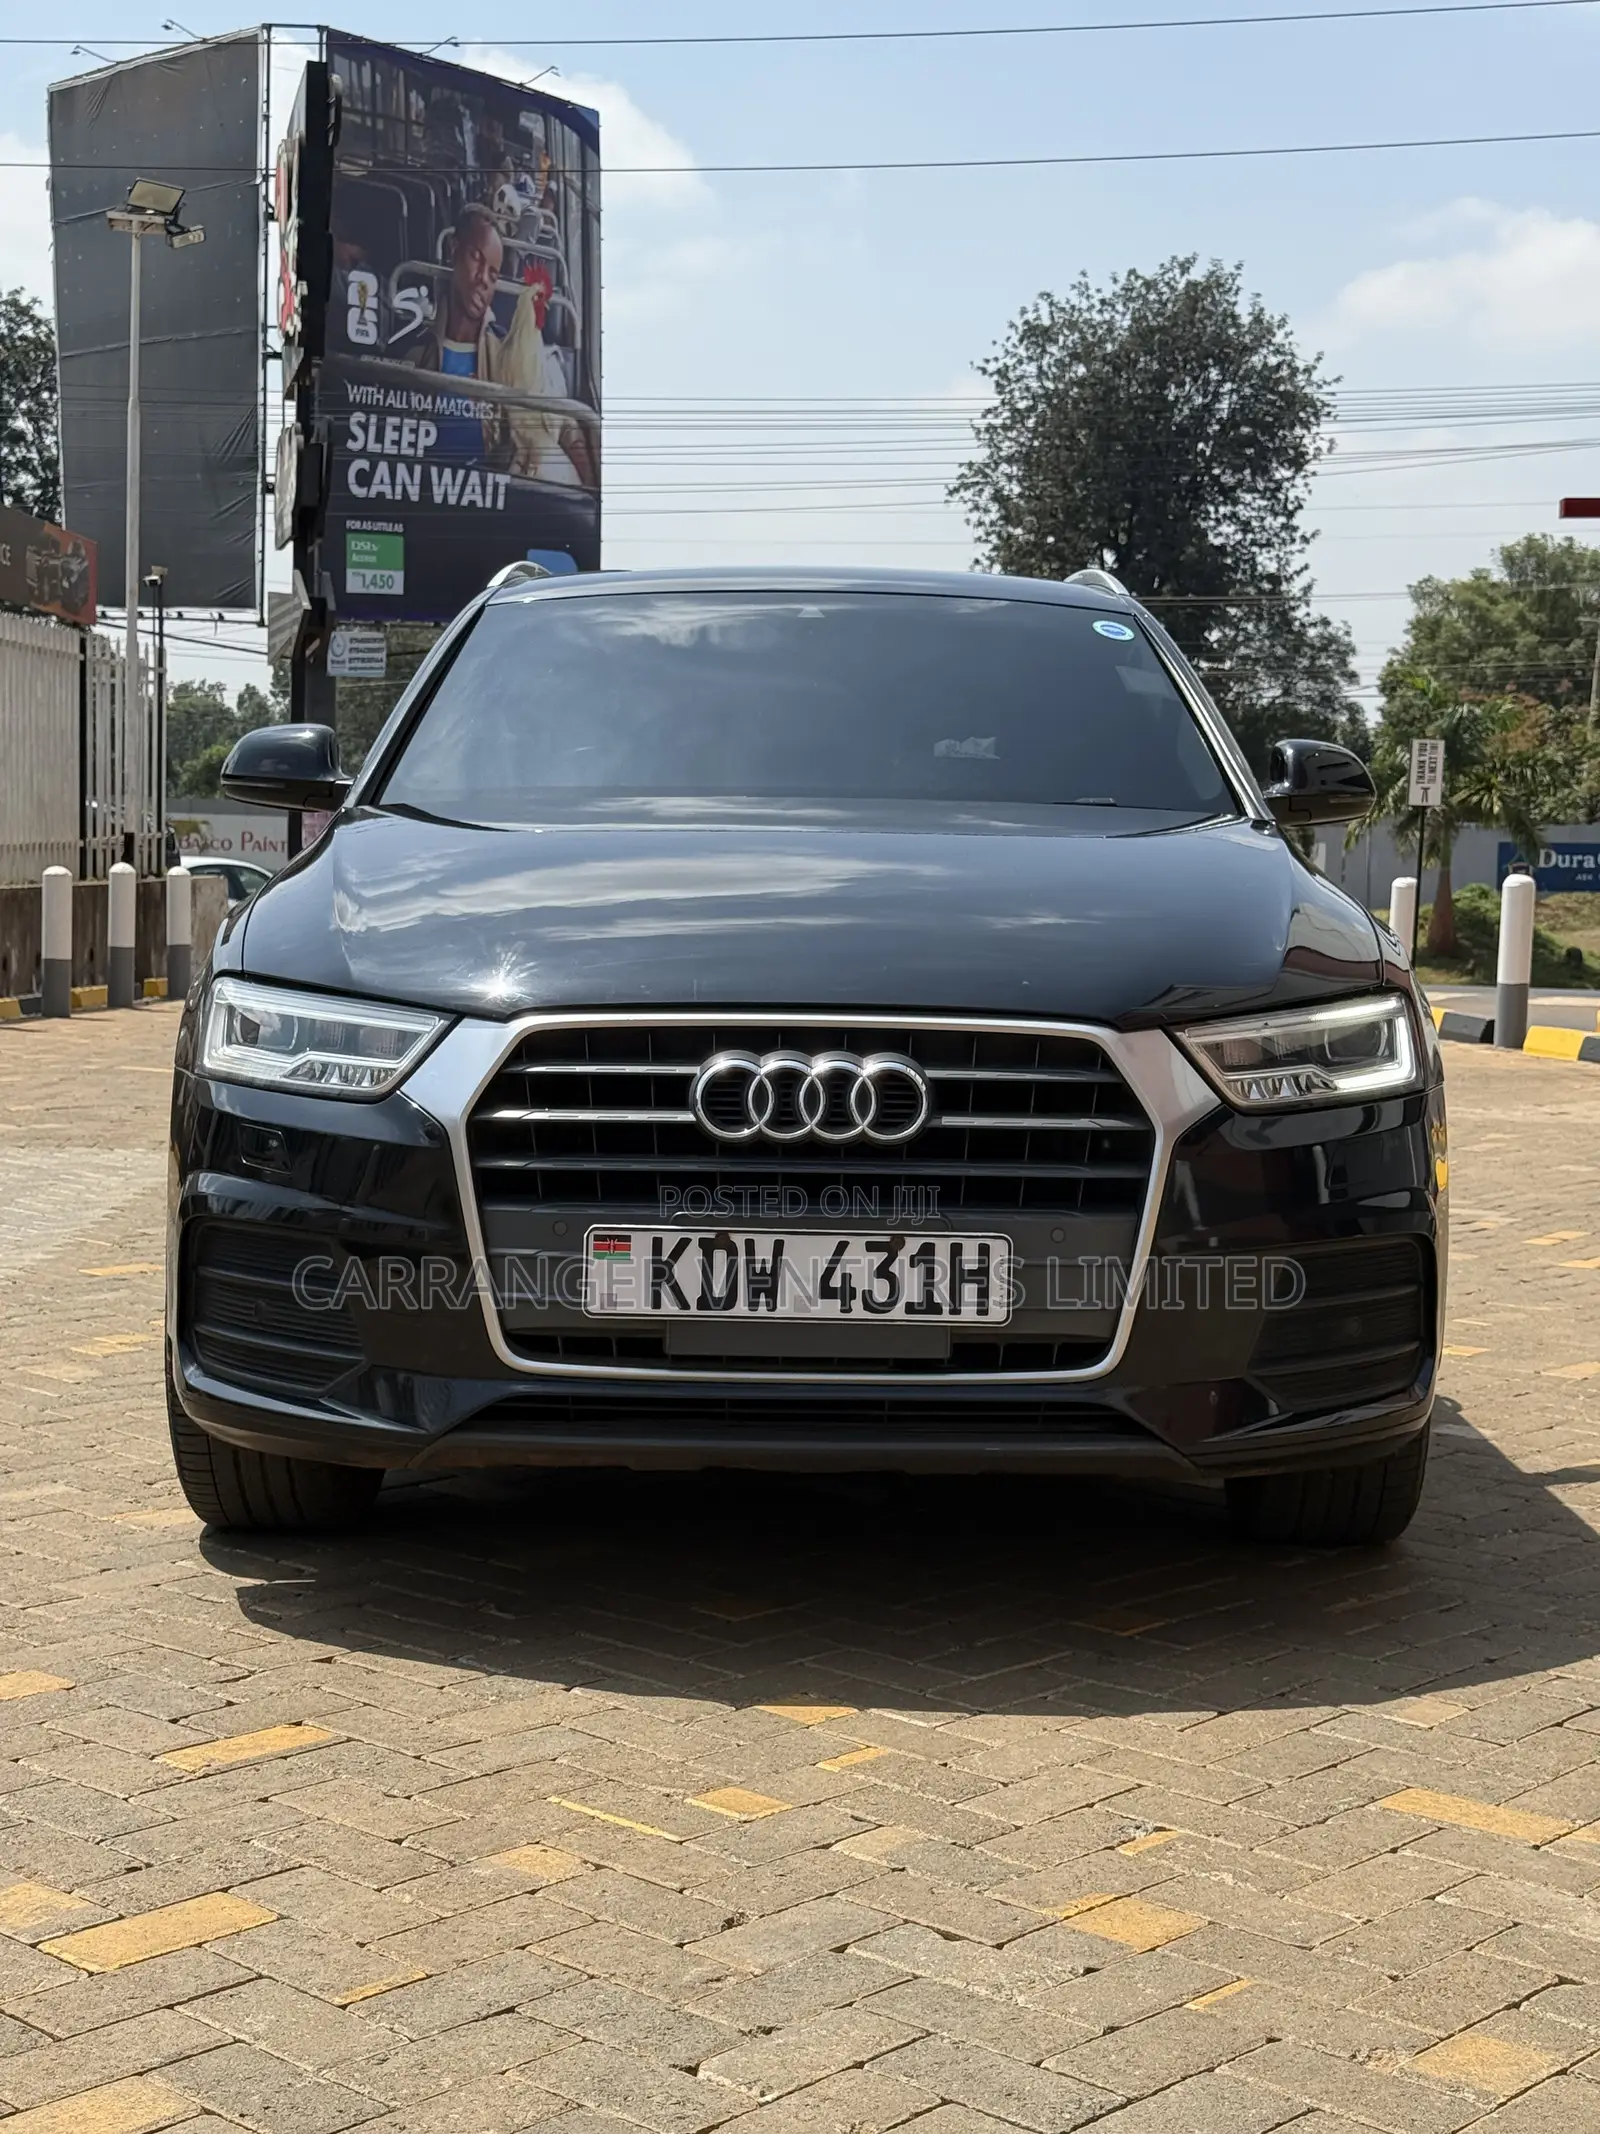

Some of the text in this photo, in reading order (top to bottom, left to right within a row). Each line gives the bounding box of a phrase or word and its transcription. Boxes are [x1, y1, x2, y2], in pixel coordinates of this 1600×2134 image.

[346, 383, 384, 406] WITH
[385, 389, 408, 409] ALL
[411, 391, 433, 412] 104
[346, 411, 438, 458] SLEEP
[347, 458, 512, 511] CAN WAIT
[346, 520, 361, 529] FOR
[362, 573, 395, 591] 1,450
[1416, 742, 1428, 785] THANK YOU
[1428, 756, 1437, 773] NEXT
[650, 1236, 785, 1312] KDW
[819, 1240, 991, 1317] 431H
